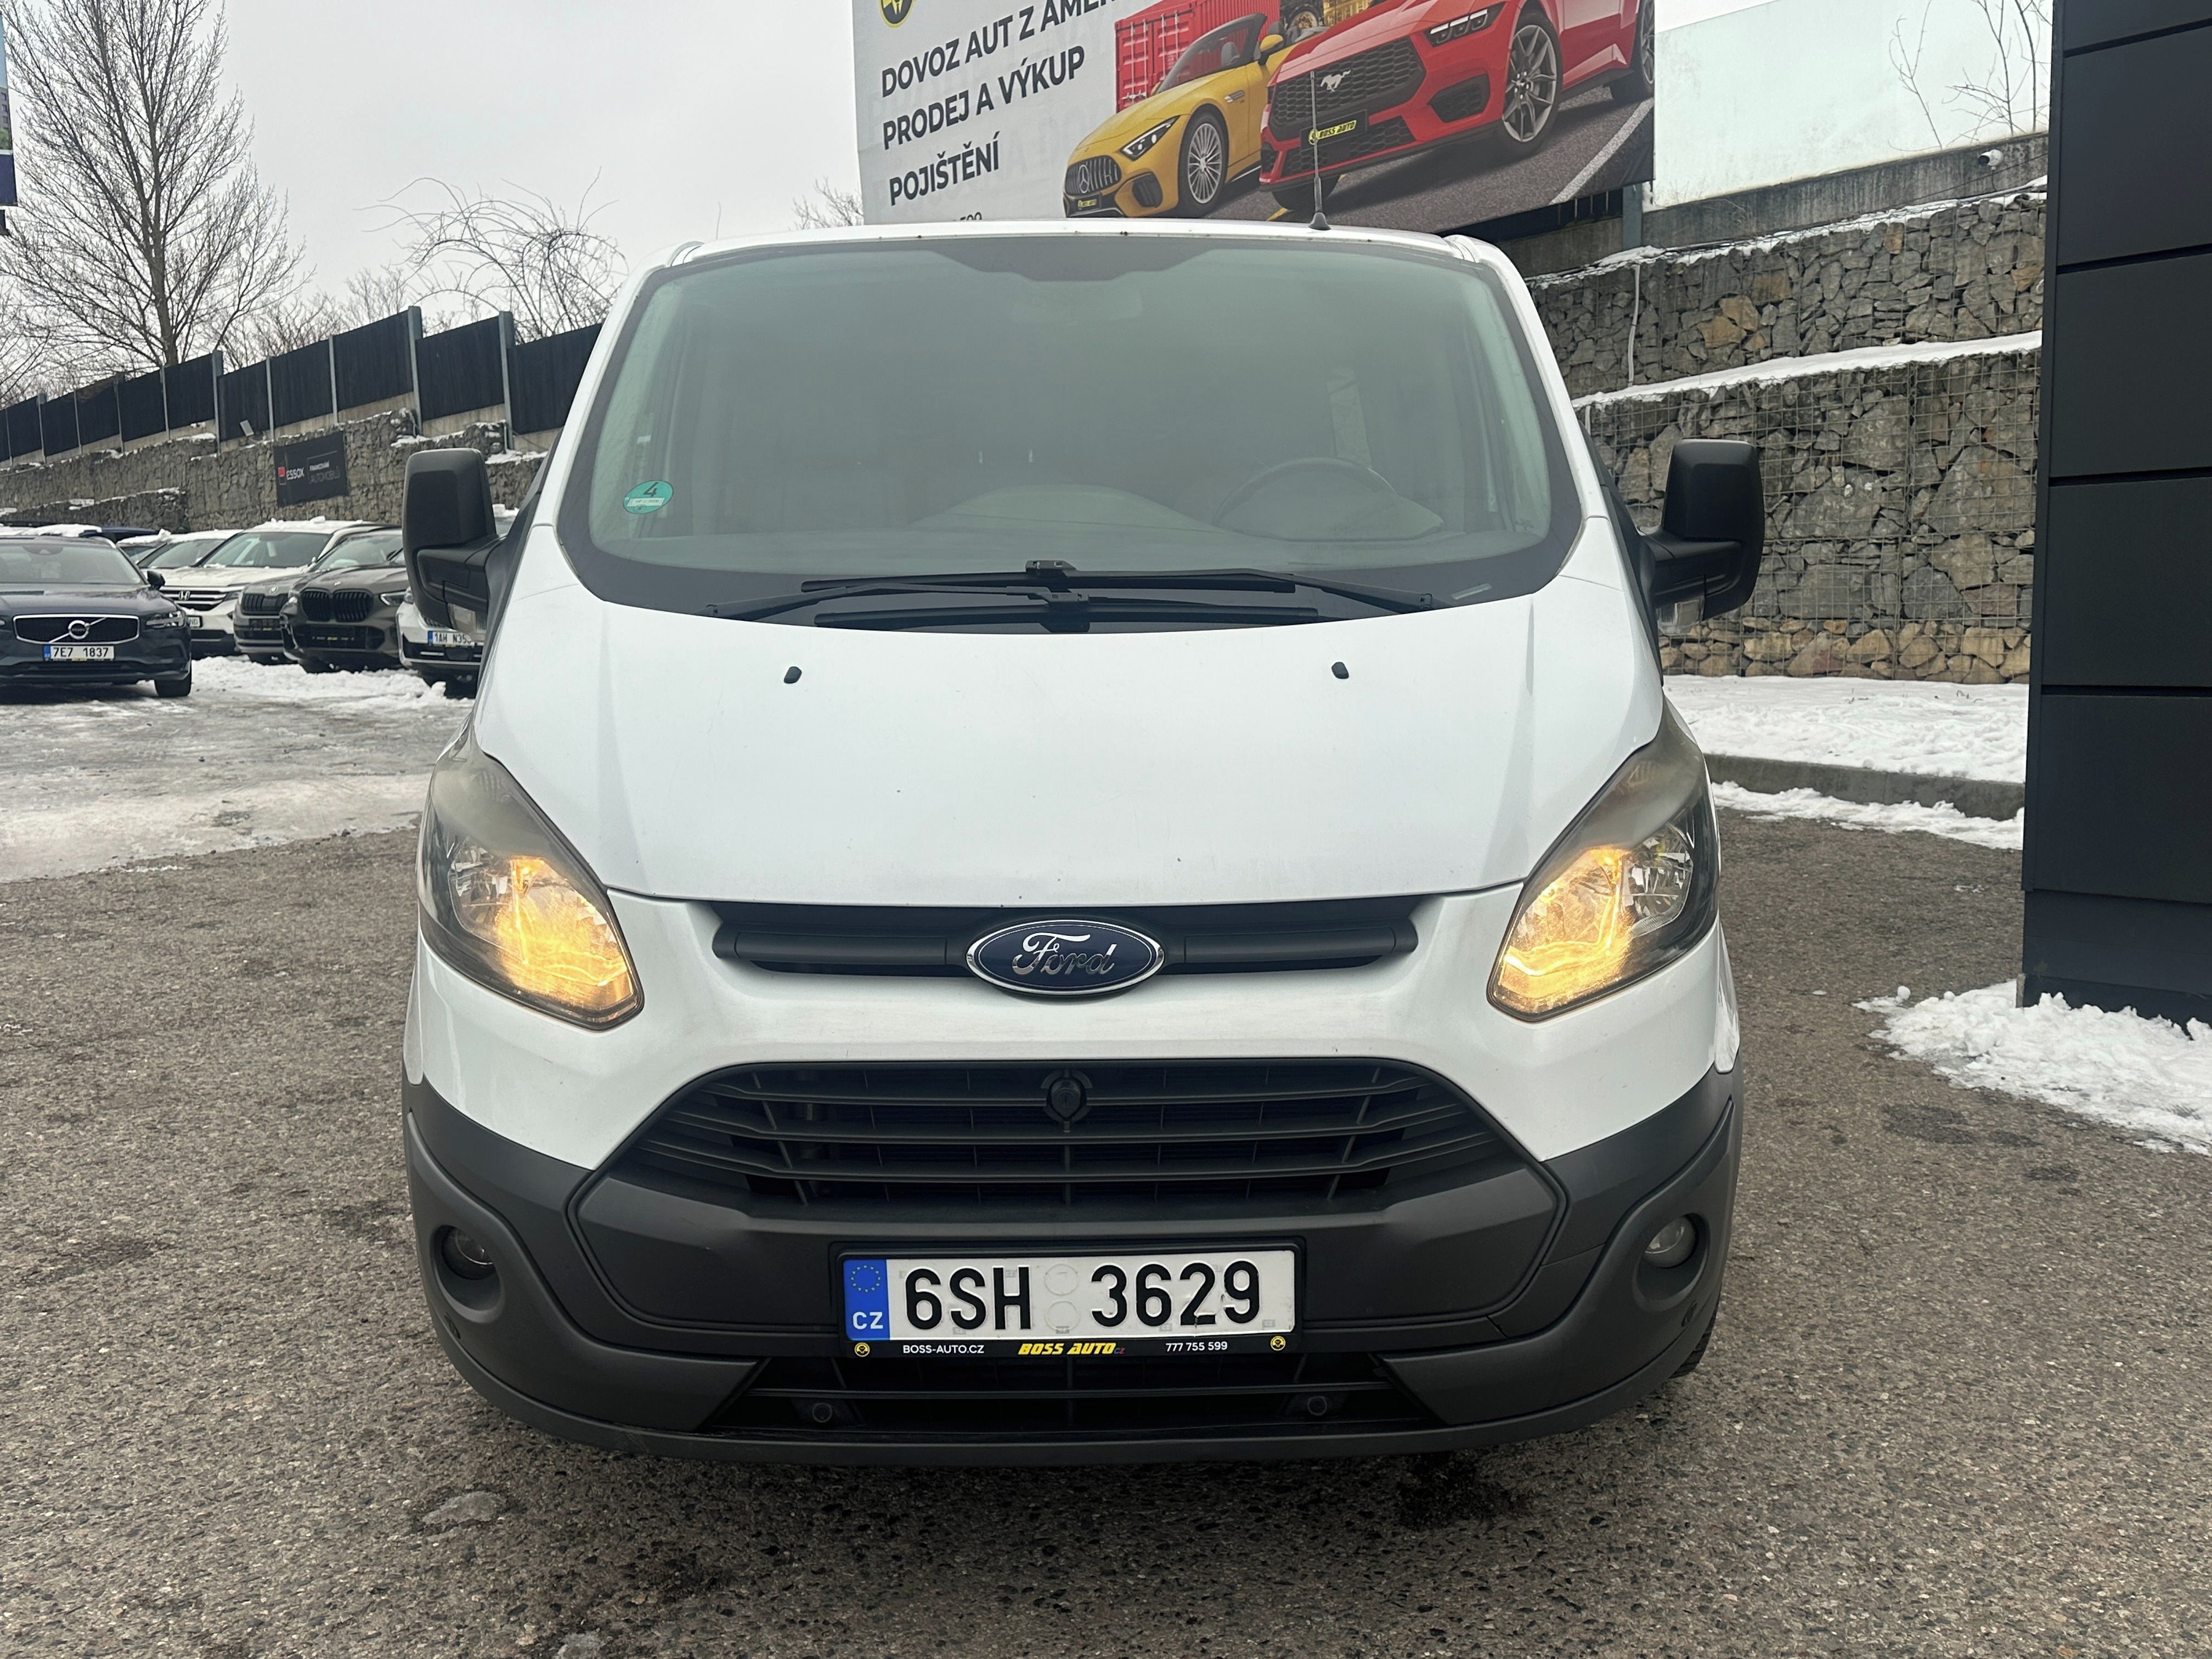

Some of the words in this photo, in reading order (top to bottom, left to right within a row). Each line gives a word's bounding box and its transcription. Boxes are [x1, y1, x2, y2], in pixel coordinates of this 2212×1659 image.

[882, 38, 960, 98] DOVOZ
[964, 14, 1013, 64] AUT
[1019, 5, 1035, 41] Z
[883, 89, 969, 150] PRODEJ
[975, 82, 995, 116] A
[997, 45, 1085, 105] VÝKUP
[889, 131, 1001, 206] POJIŠTĚNÍ
[286, 467, 304, 481] ESSOX
[643, 482, 659, 497] 4
[453, 633, 472, 644] N35
[53, 647, 74, 657] 7E7
[83, 647, 109, 657] 1837
[1011, 932, 1118, 975] Ford
[905, 1266, 1031, 1330] 6SH
[1091, 1260, 1260, 1327] 3629
[852, 1312, 884, 1330] CZ
[902, 1345, 985, 1354] BOSS-AUTO.CZ
[1018, 1342, 1064, 1355] BOSS
[1165, 1342, 1184, 1352] 777
[1186, 1342, 1205, 1351] 755
[1207, 1341, 1228, 1350] 599
